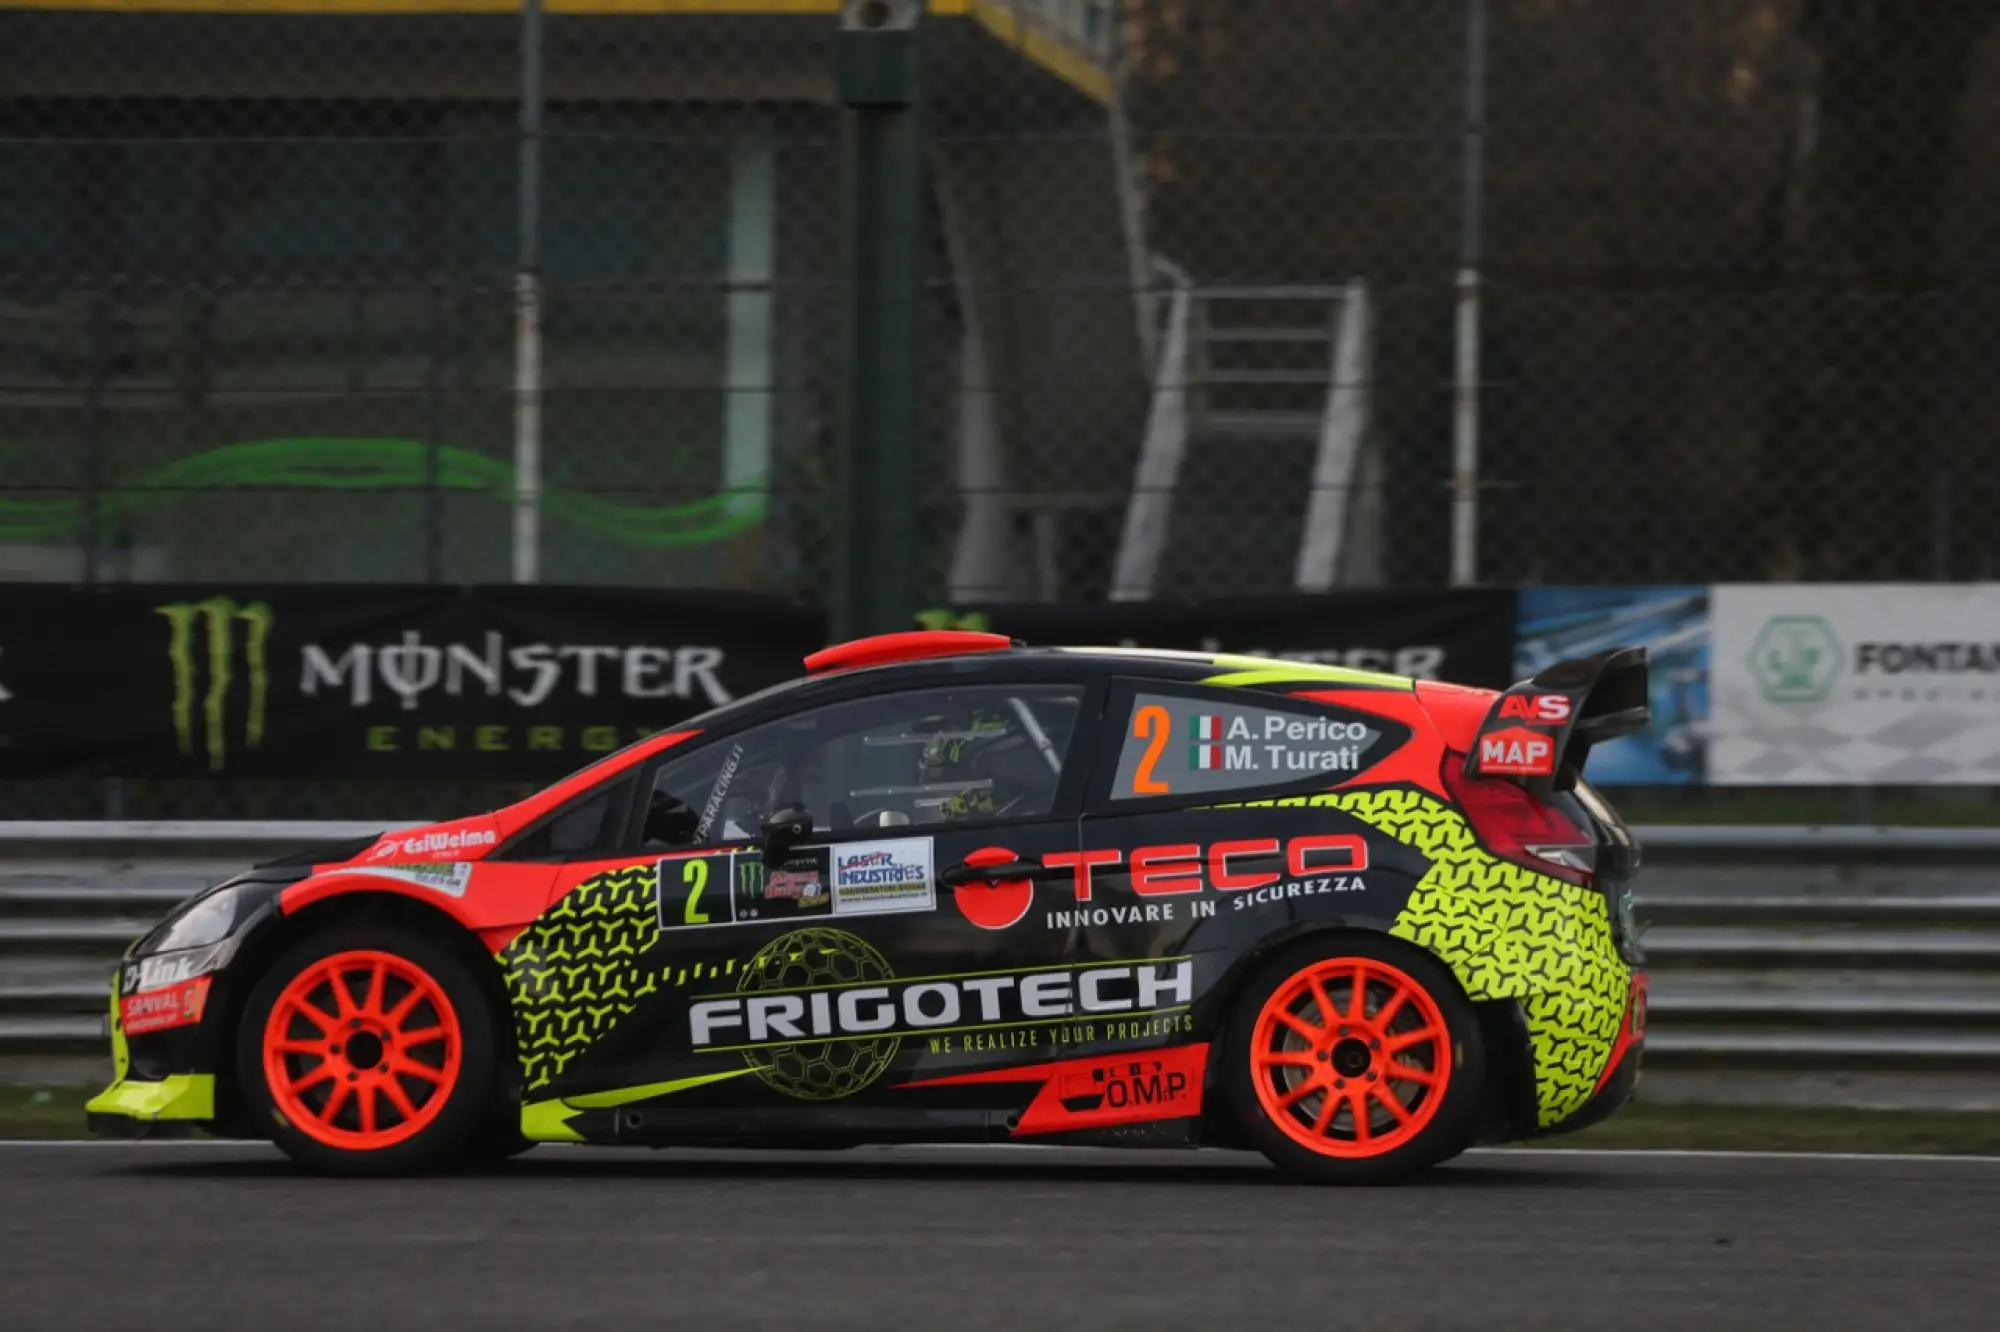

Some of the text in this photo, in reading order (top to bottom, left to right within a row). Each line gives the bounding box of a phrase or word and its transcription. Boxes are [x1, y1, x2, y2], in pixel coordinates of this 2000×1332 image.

[301, 630, 732, 709] MONSTER
[1854, 641, 2000, 675] FONTA
[1226, 715, 1368, 740] A. Perico
[1498, 694, 1571, 719] AVS
[1133, 704, 1171, 794] 2
[1224, 745, 1360, 771] M. Turati
[1482, 739, 1549, 765] MAP
[1042, 834, 1368, 902] TECO
[682, 859, 710, 924] 2
[1046, 876, 1366, 929] INNOVARE IN SICUREZZA
[688, 961, 1193, 1046] FRIGOTECH
[929, 1014, 1194, 1054] WE REALIZE YOUR PROJECTS
